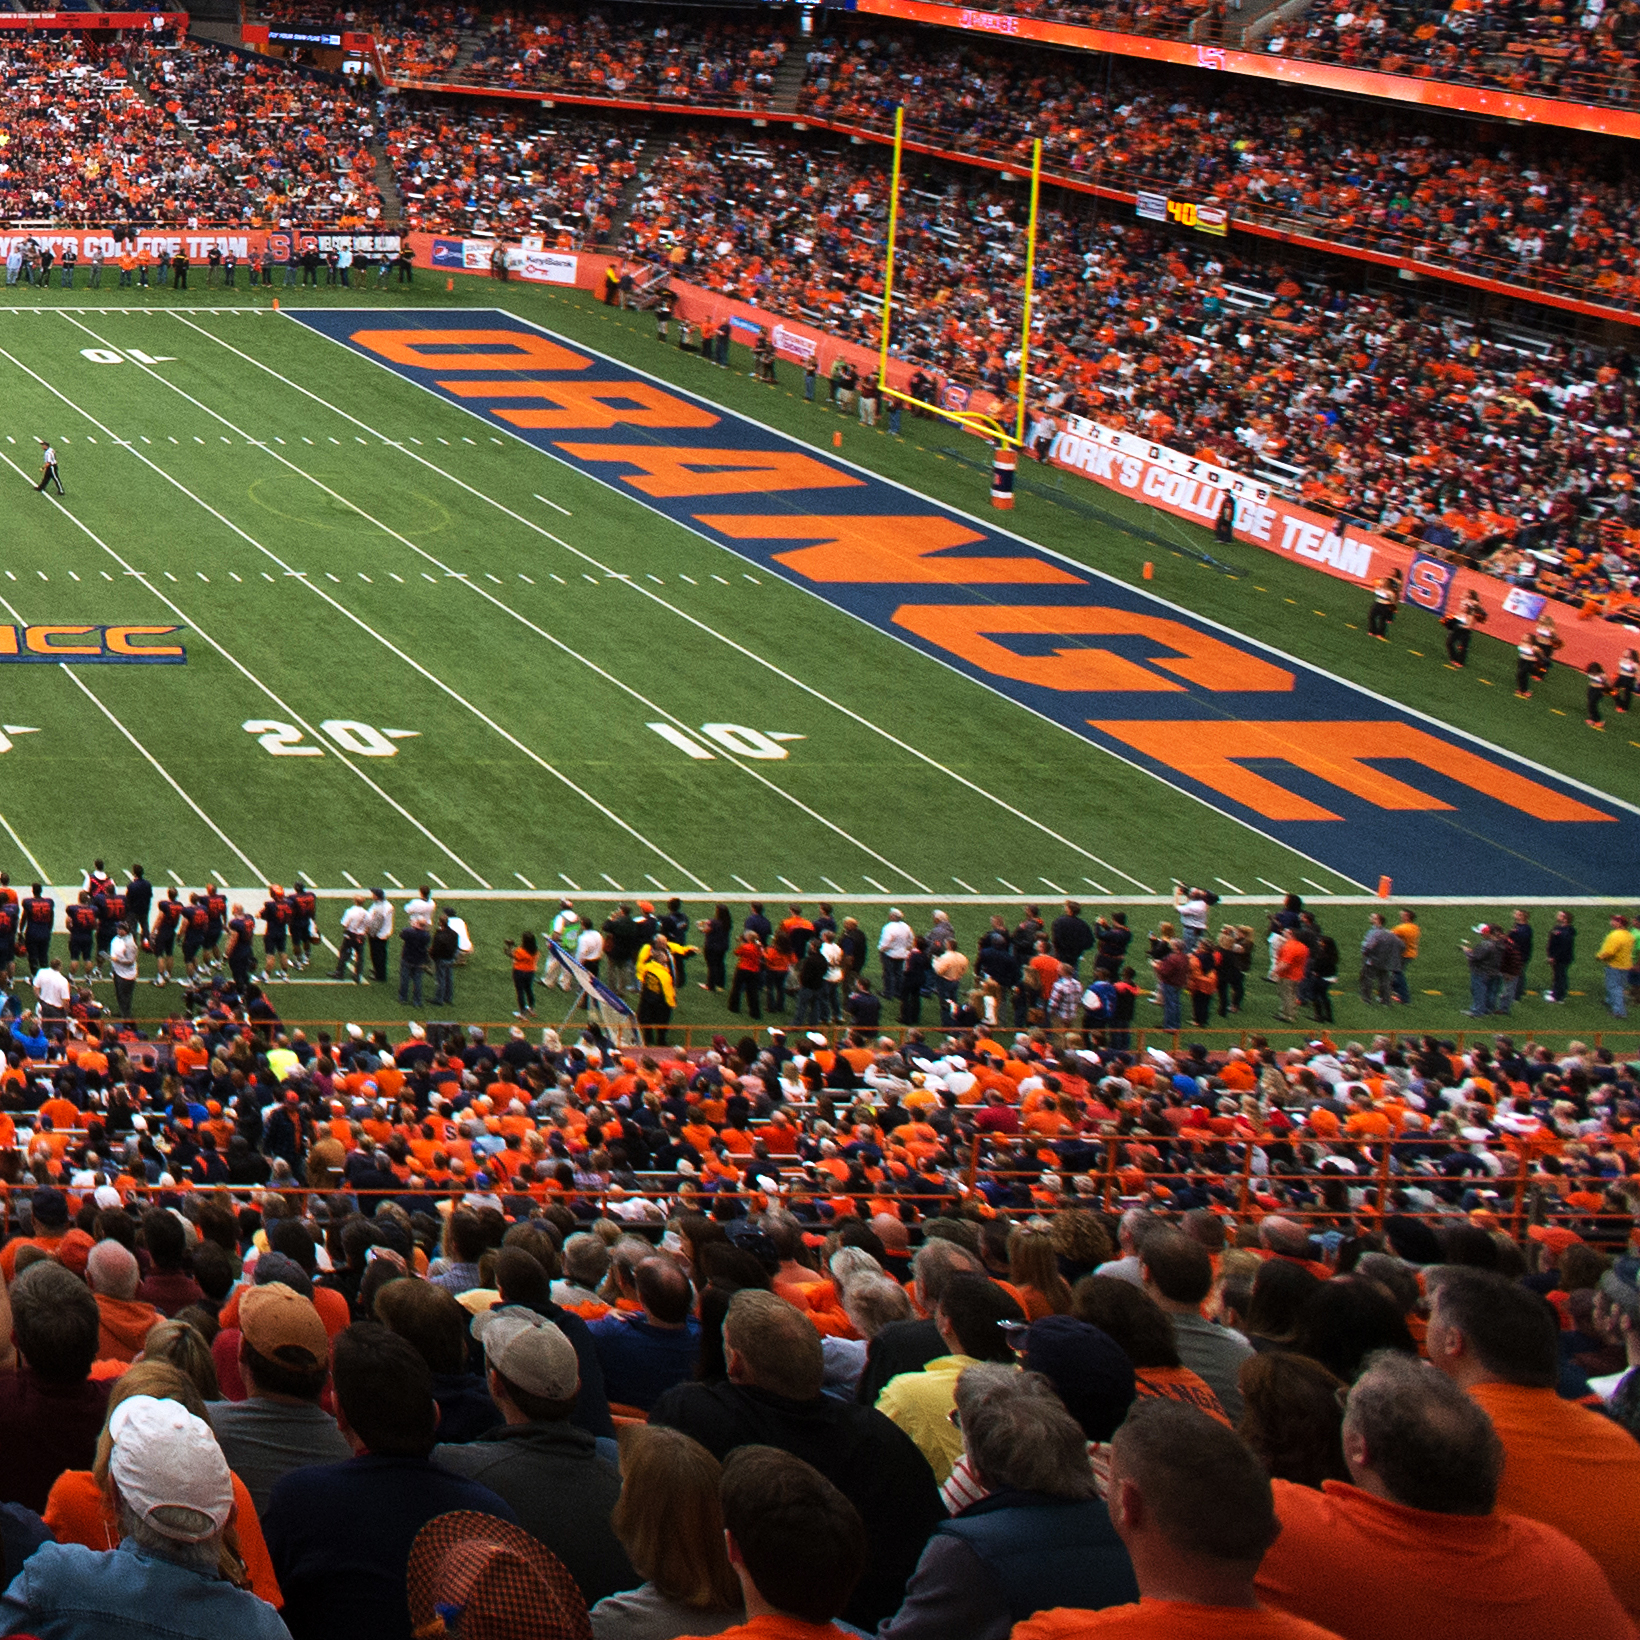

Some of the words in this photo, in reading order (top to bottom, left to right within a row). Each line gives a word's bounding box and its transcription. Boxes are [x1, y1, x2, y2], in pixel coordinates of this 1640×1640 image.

[1166, 200, 1197, 227] 40
[187, 237, 248, 258] TEAM
[526, 254, 574, 268] KeyBank
[1142, 465, 1274, 543] COLLGE
[1280, 512, 1373, 578] TEAM
[349, 328, 1622, 824] ORANGE
[1410, 558, 1450, 611] S
[241, 720, 403, 757] 20
[643, 721, 793, 760] 10
